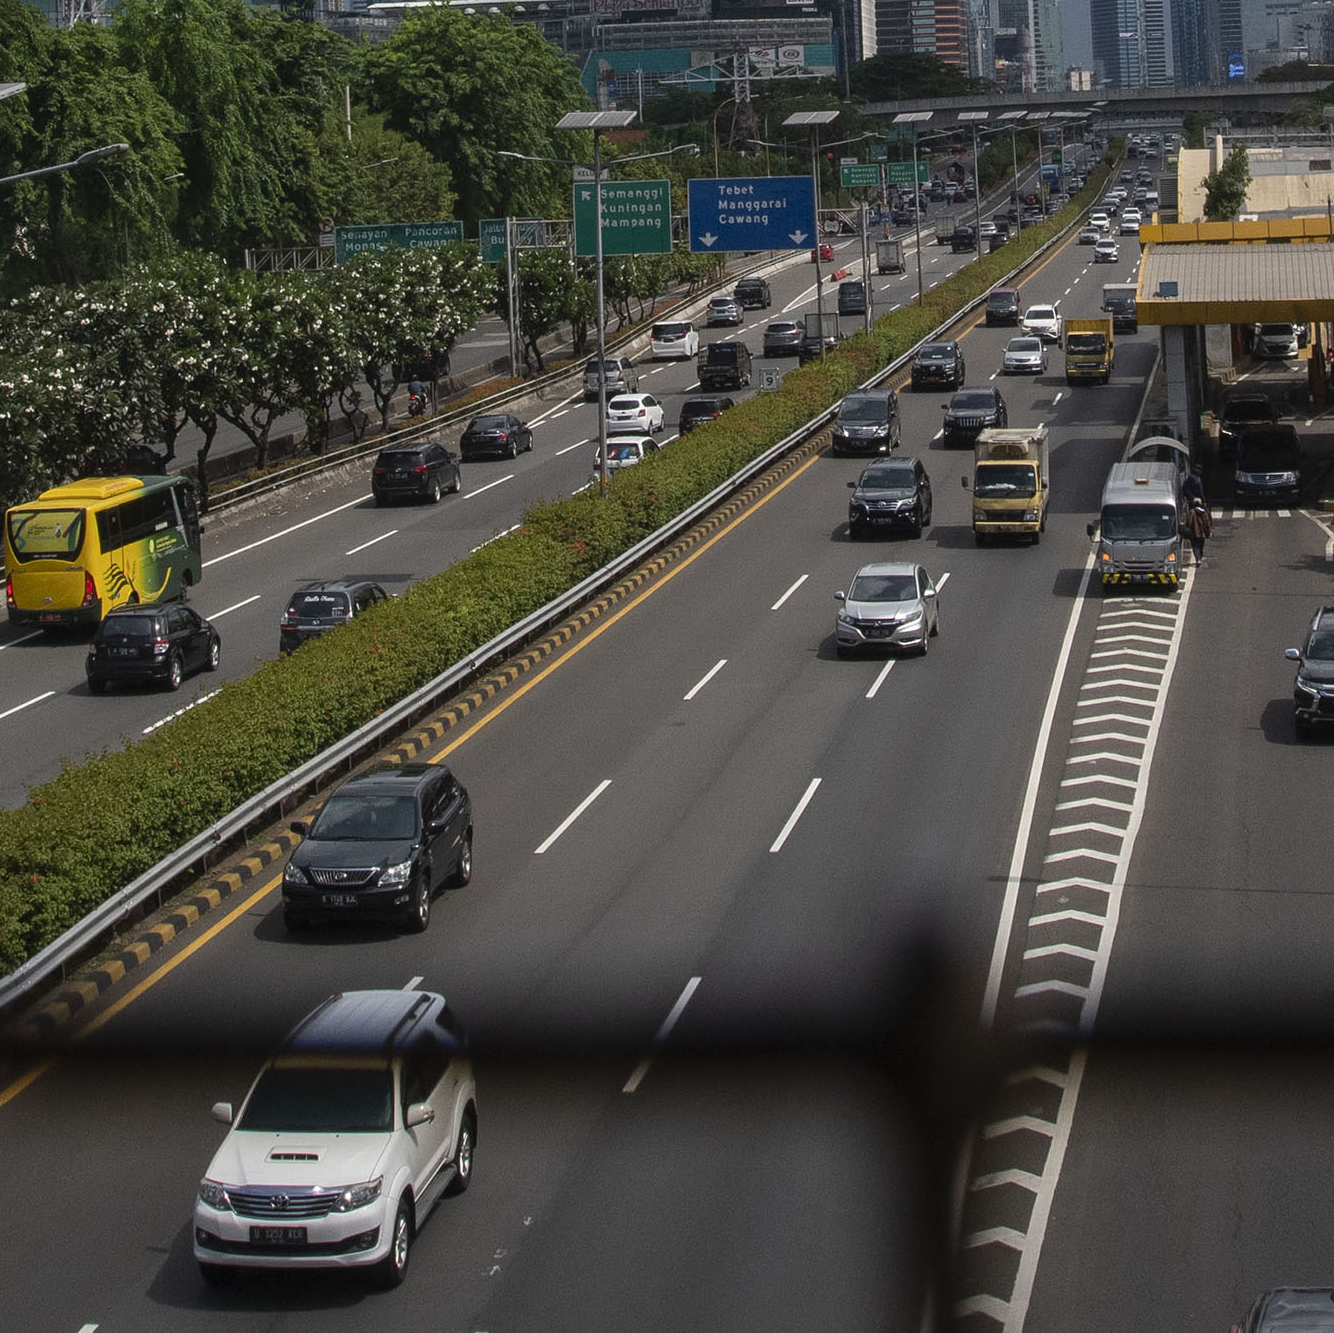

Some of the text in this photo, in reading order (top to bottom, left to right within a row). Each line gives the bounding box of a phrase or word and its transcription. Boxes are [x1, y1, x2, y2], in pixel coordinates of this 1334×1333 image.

[601, 188, 663, 200] Semanggi
[718, 185, 754, 195] Tebet
[600, 203, 662, 215] Kuningan
[718, 198, 787, 211] Manggarai
[600, 218, 661, 229] Mampang
[719, 214, 768, 226] Cawang
[341, 228, 387, 240] Senayan
[405, 225, 457, 237] Pancoran
[766, 376, 774, 386] 9
